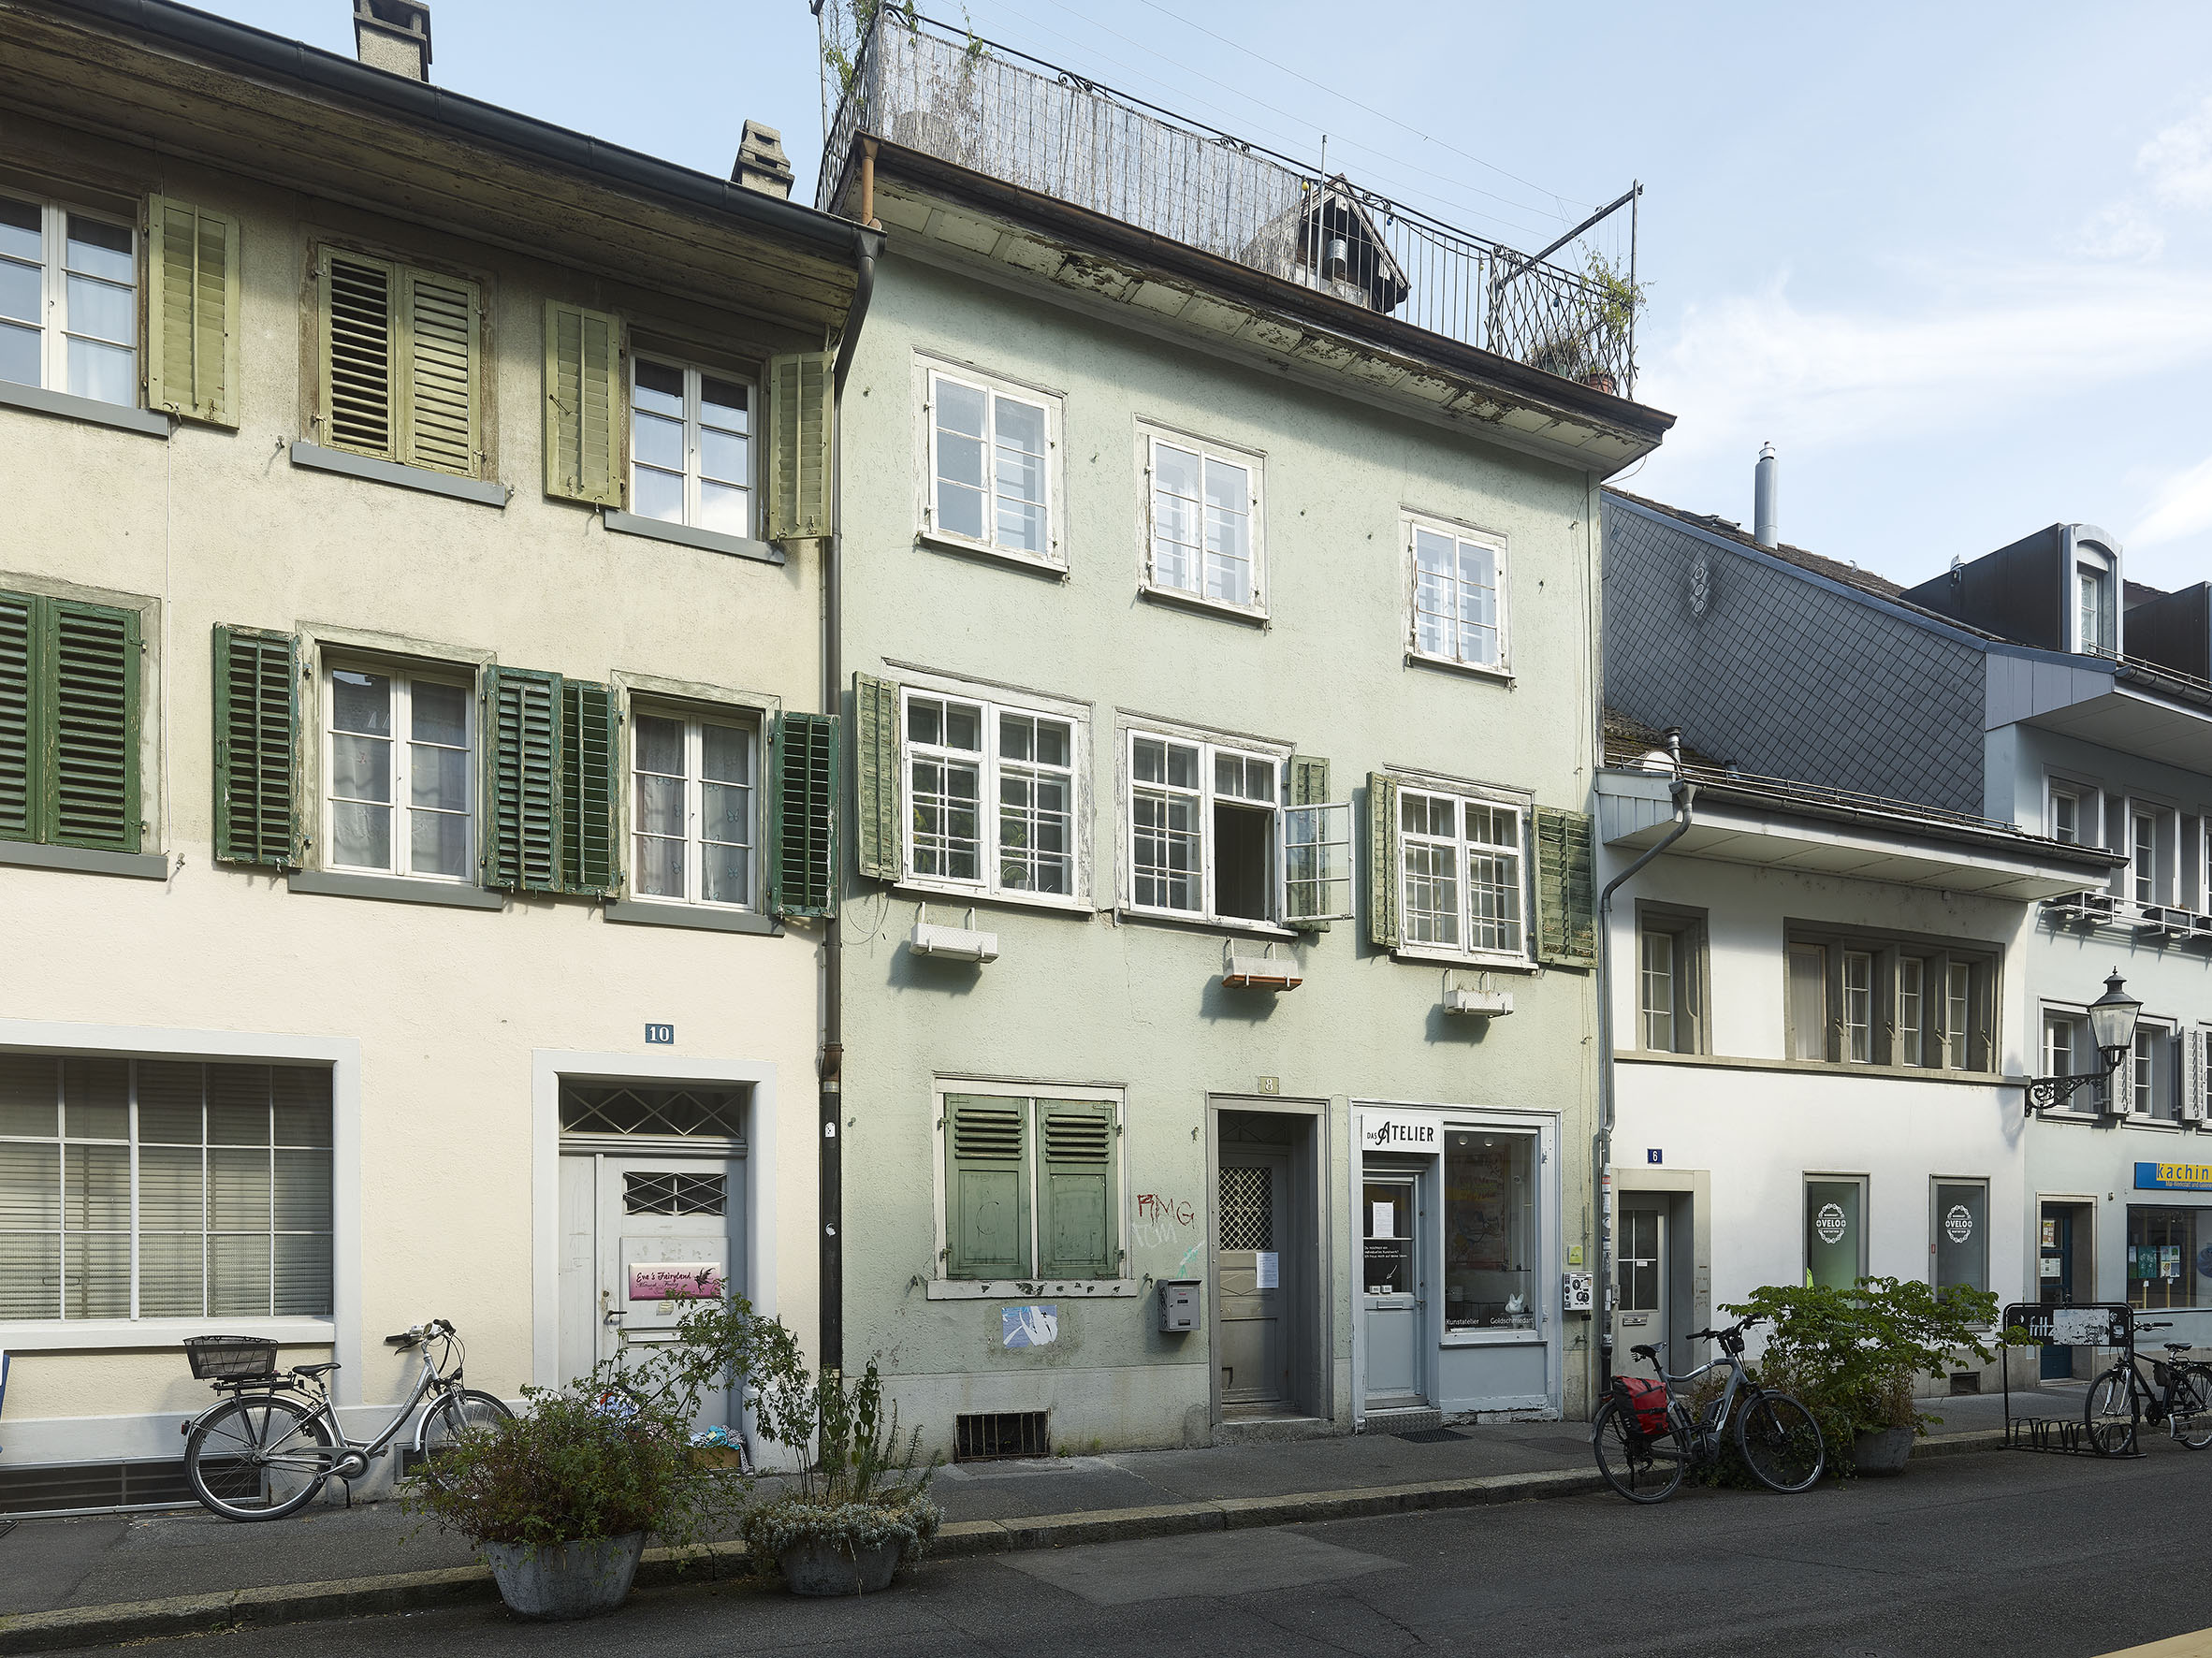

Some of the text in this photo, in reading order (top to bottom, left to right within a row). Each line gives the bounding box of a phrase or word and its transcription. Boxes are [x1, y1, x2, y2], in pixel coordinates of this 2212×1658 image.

[650, 1026, 669, 1041] 10
[1265, 1079, 1273, 1091] 8
[1366, 1121, 1433, 1146] DAS ATELIER
[1652, 1150, 1658, 1162] 6
[657, 1272, 691, 1283] Fairyland
